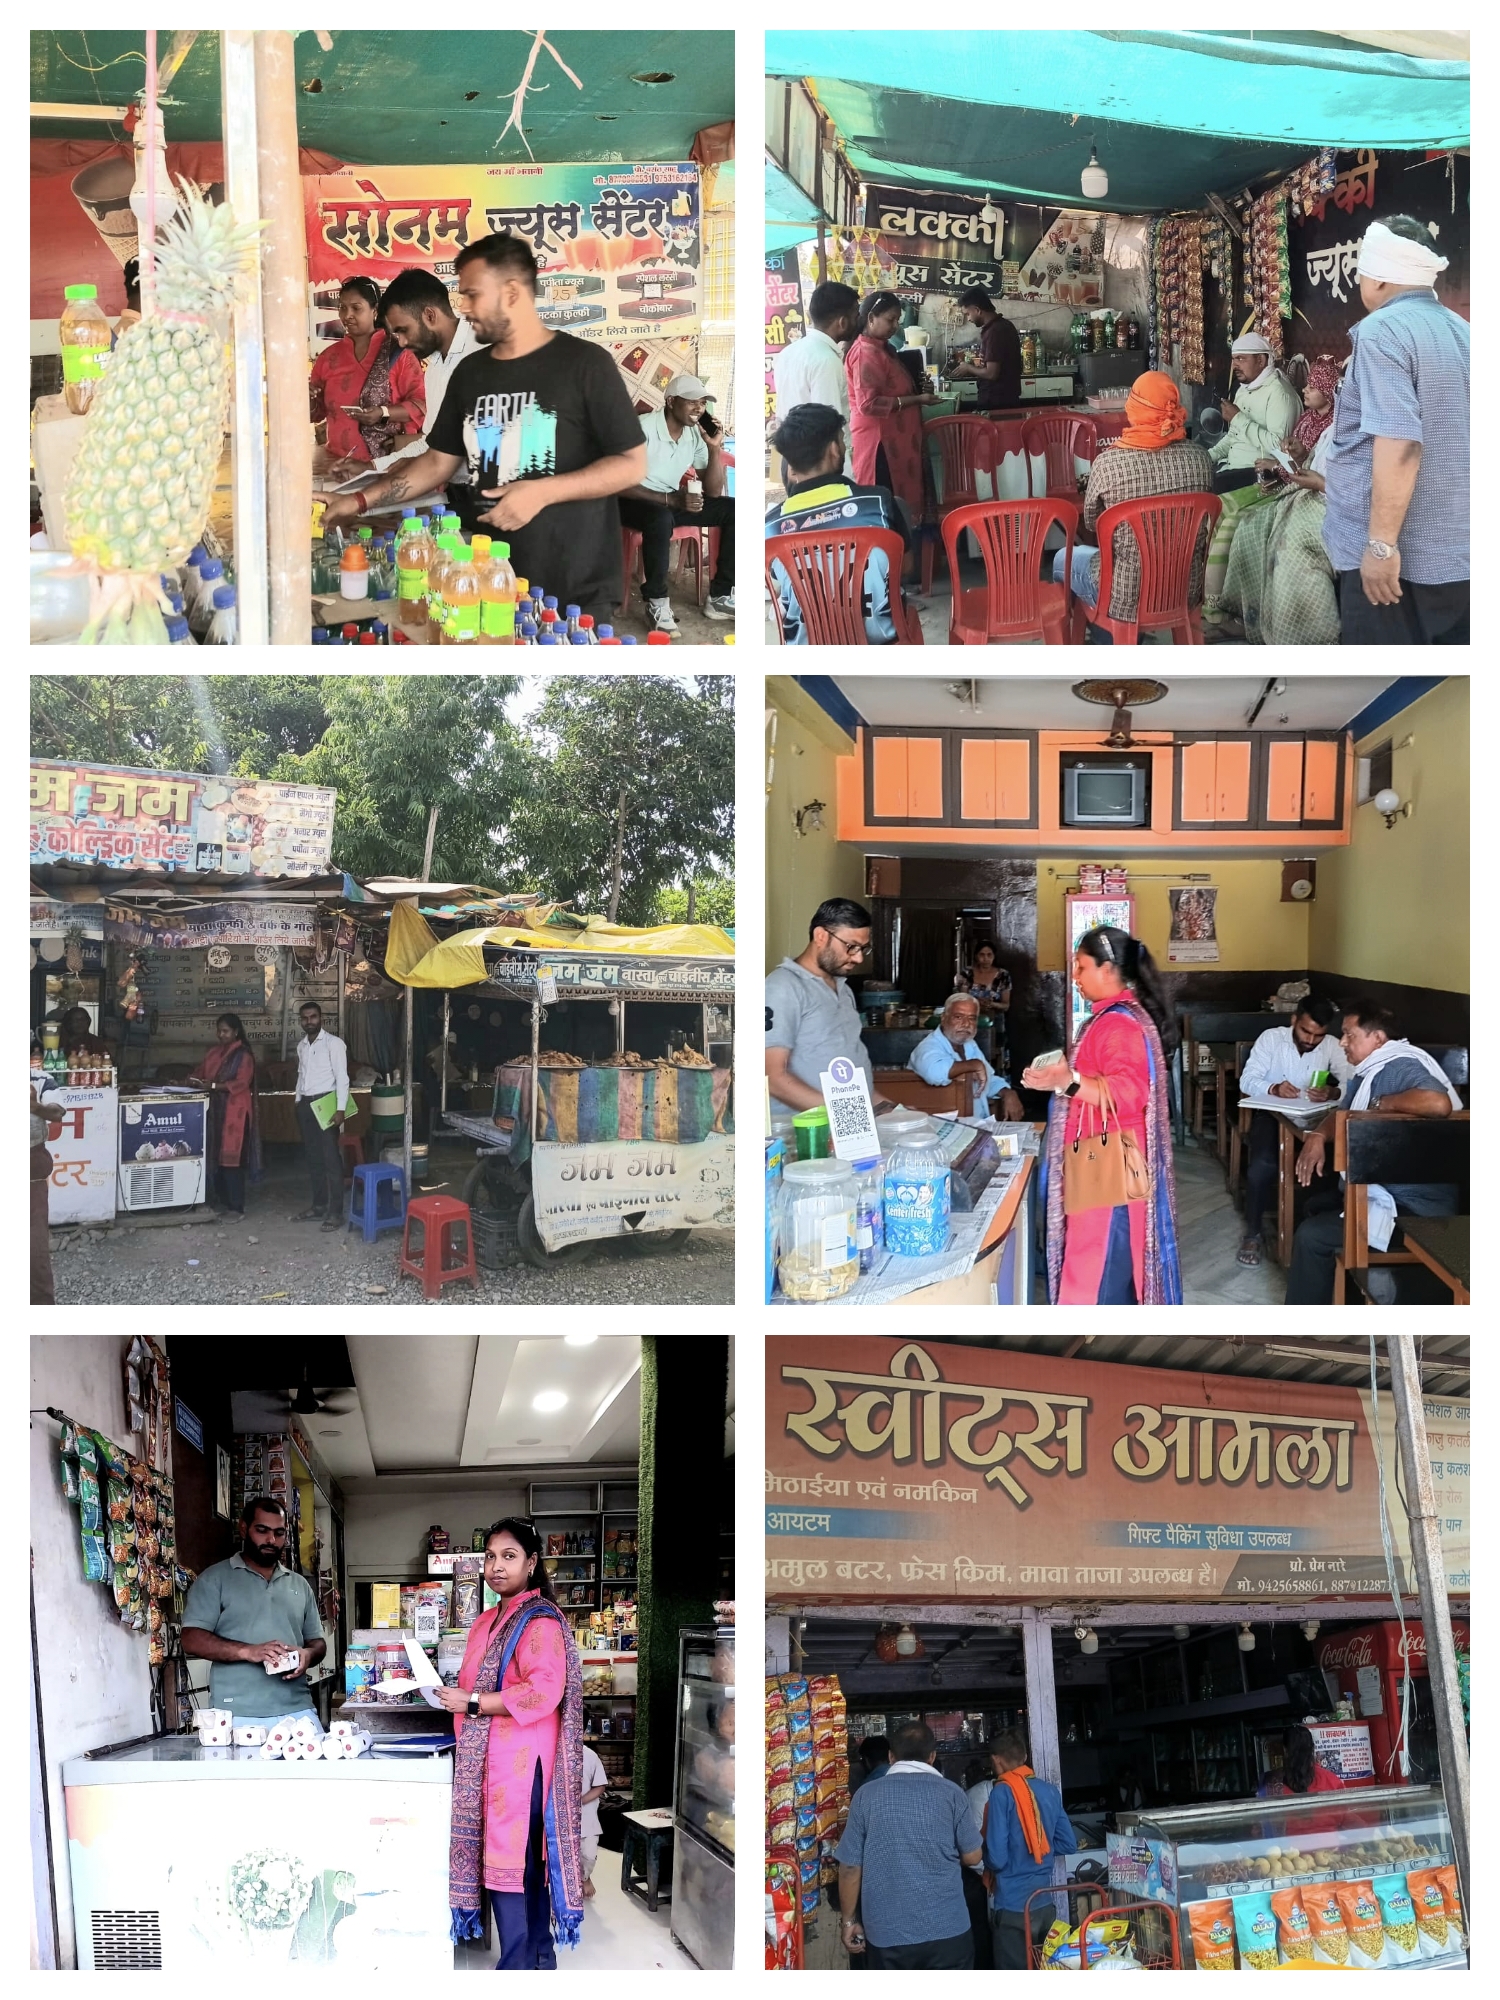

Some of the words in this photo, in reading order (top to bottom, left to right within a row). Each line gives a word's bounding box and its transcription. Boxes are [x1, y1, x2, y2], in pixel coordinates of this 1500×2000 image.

[322, 179, 472, 257] सोनम
[486, 202, 581, 254] ज्यूस
[592, 188, 668, 241] सेंटर
[539, 277, 563, 287] पपीता
[565, 276, 585, 287] ज्यूस
[940, 261, 995, 289] सेंटर
[474, 391, 536, 428] EARTH
[85, 772, 197, 822] जम
[585, 963, 620, 986] जम
[835, 1062, 848, 1080] पे
[831, 1083, 861, 1095] PhonePe
[144, 1112, 183, 1128] Amul
[886, 1204, 909, 1218] Center
[909, 1204, 932, 1219] fresh
[1422, 1398, 1453, 1418] स्पेशल
[781, 1343, 1089, 1505] स्वीट्स
[1113, 1403, 1355, 1488] आमला
[855, 1476, 887, 1501] एवं
[892, 1478, 979, 1504] नमकिन
[767, 1510, 831, 1533] आयटम
[1446, 1518, 1462, 1532] पान
[1127, 1522, 1162, 1545] गिफ्ट
[1166, 1522, 1201, 1546] पैकिंग
[1205, 1525, 1244, 1551] सुविधा
[1247, 1530, 1292, 1548] उपलब्ध
[835, 1560, 892, 1583] बटर,
[899, 1554, 947, 1583] फ्रेस
[1019, 1564, 1069, 1585] मावा
[1074, 1565, 1122, 1586] ताजा
[1128, 1565, 1193, 1585] उपलब्ध
[1289, 1556, 1307, 1573] प्रो.
[1309, 1557, 1325, 1573] प्रेम
[1327, 1557, 1347, 1572] नारे
[1237, 1576, 1255, 1593] मो.
[1258, 1578, 1328, 1594] 9425658861,
[1388, 1897, 1411, 1909] BALAJI
[1210, 1927, 1233, 1940] BALAJI
[1251, 1921, 1275, 1934] BALAJI
